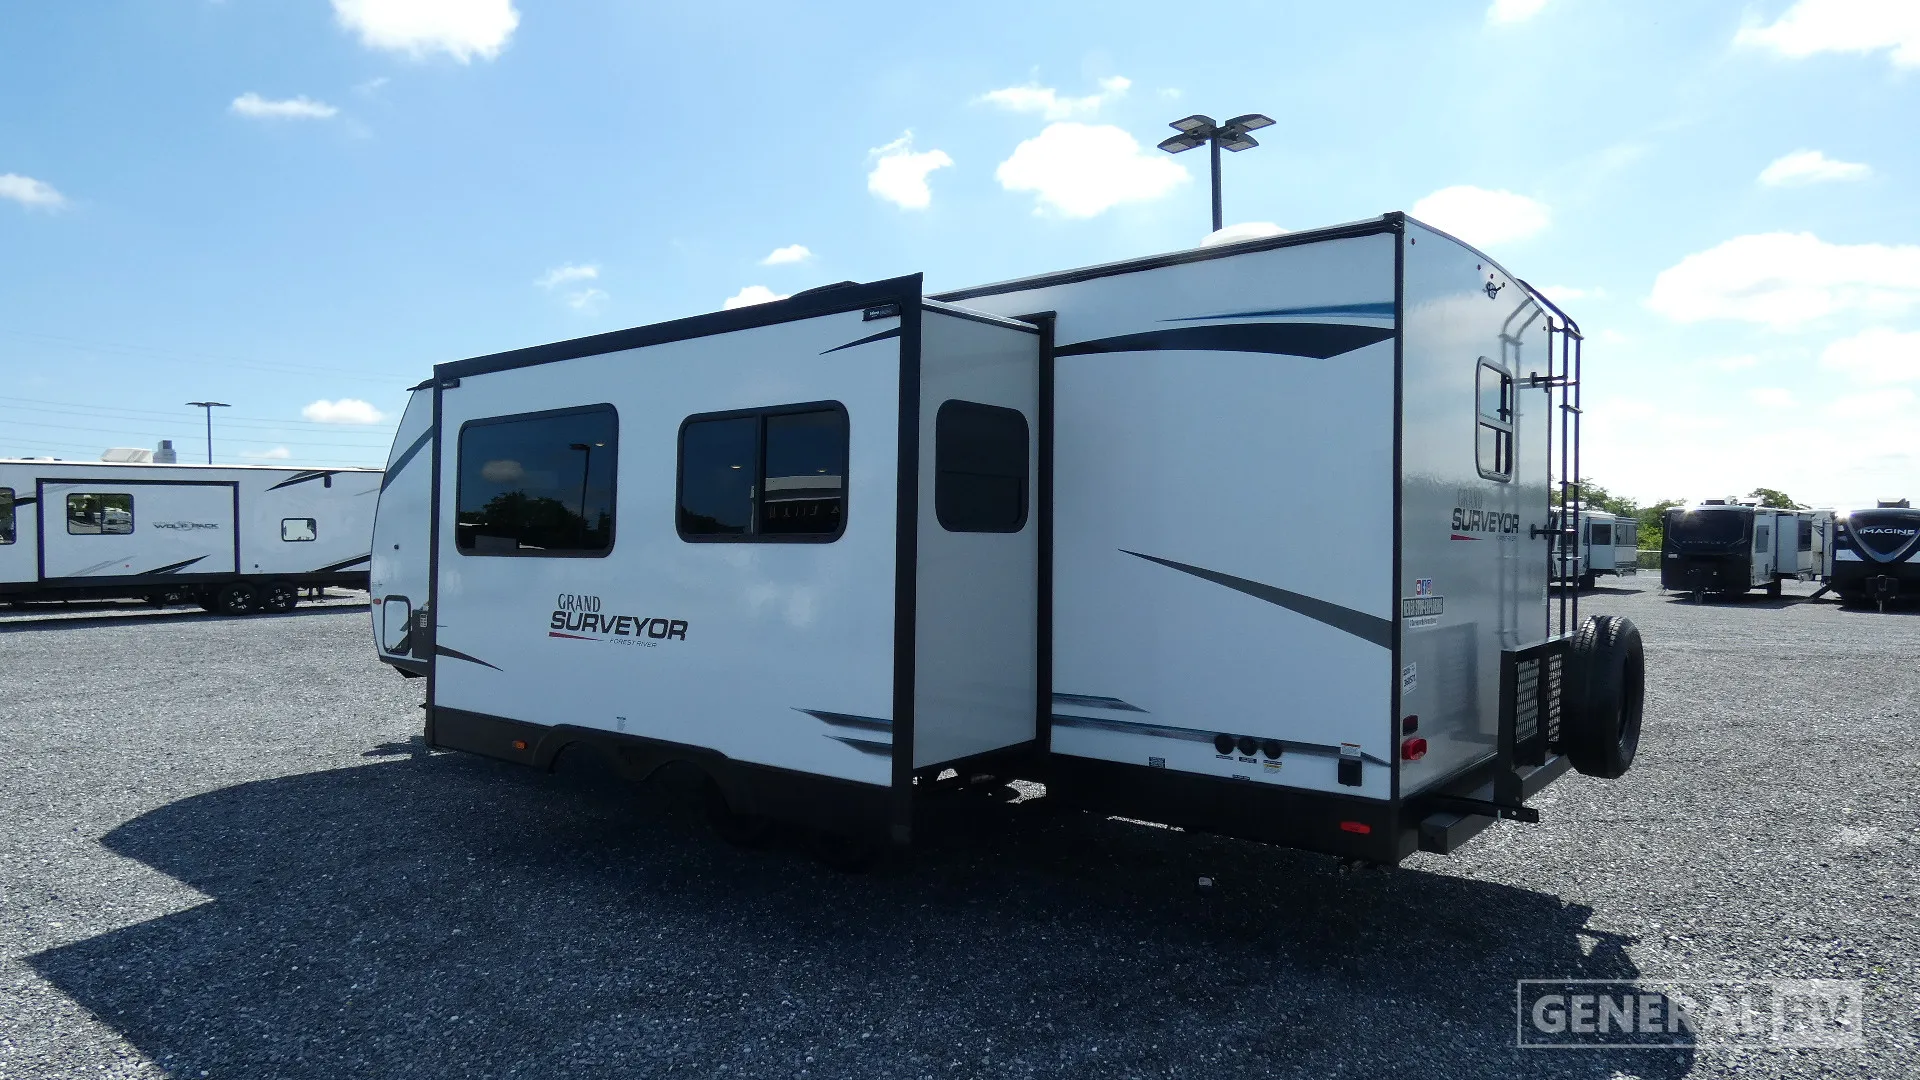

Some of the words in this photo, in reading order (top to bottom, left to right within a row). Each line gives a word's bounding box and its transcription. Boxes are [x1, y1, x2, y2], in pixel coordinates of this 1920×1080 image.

[1452, 508, 1519, 533] SURVEYOR
[1860, 528, 1916, 536] IMAGINE
[557, 593, 601, 612] GRAND
[550, 610, 689, 641] SURVEYOR
[609, 637, 636, 646] FOREST
[636, 639, 658, 648] RIVER
